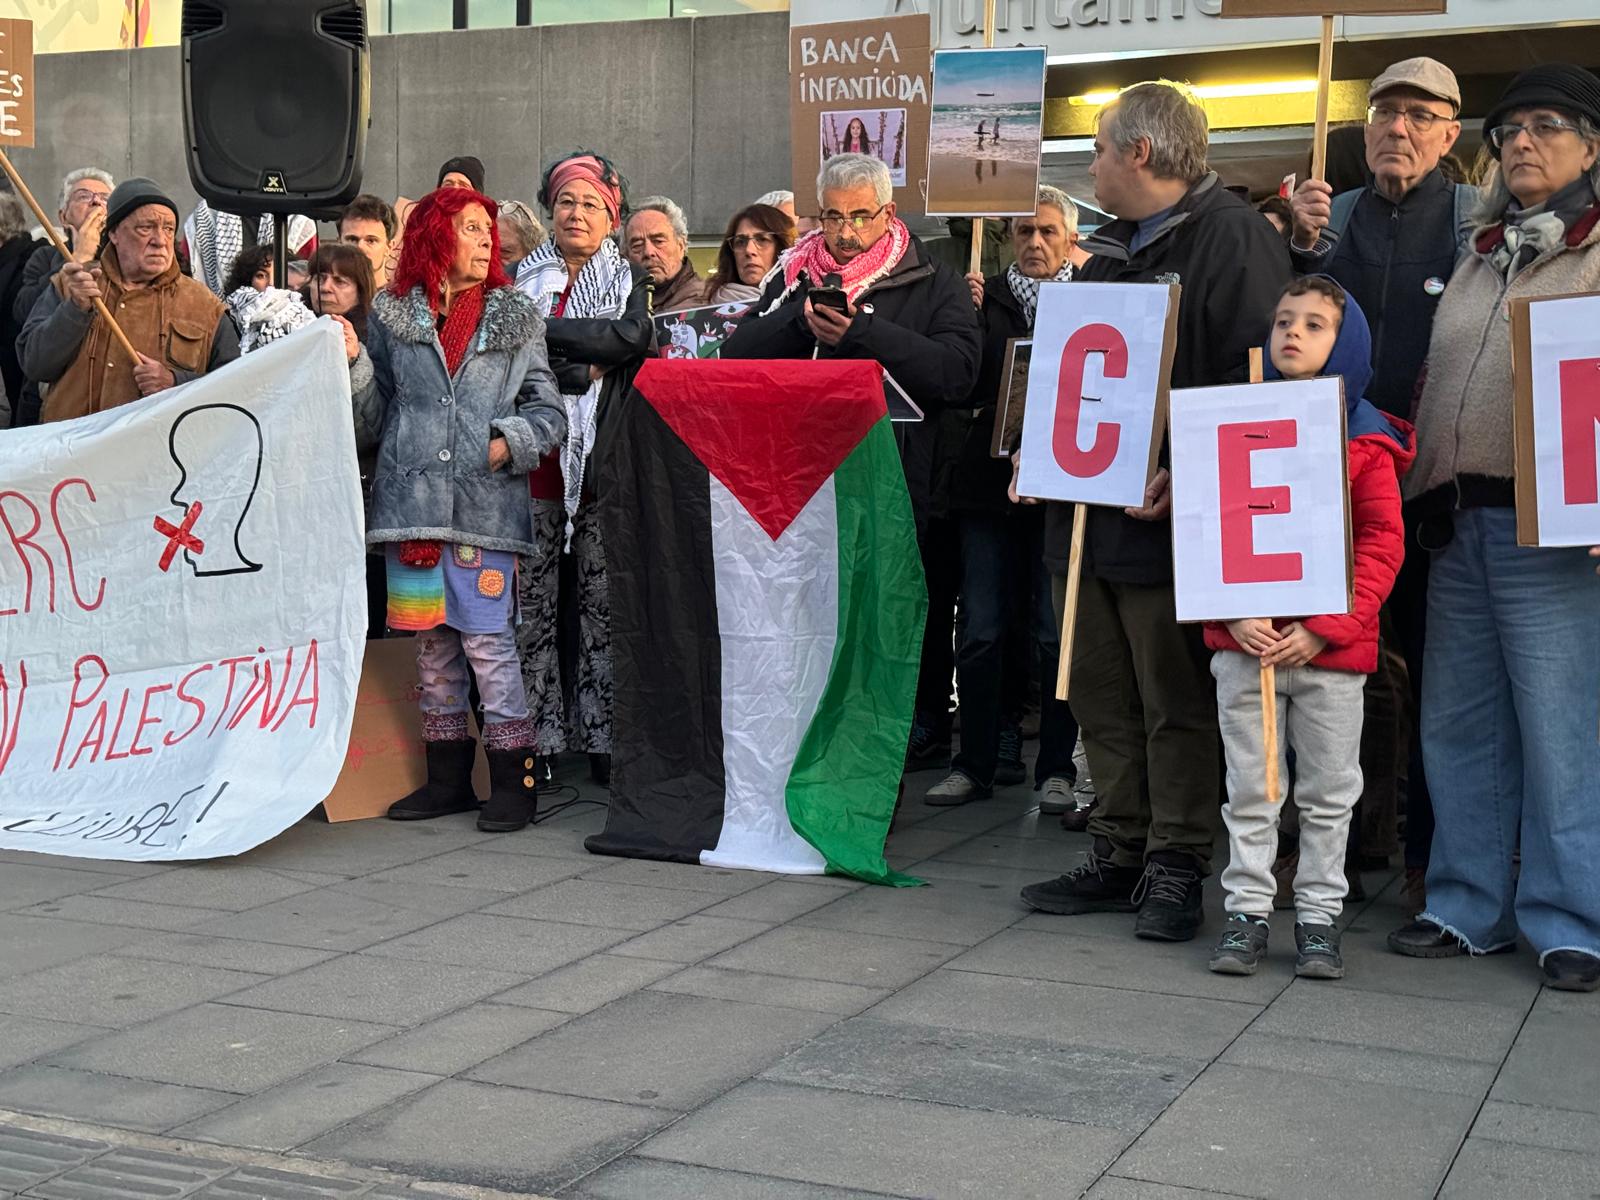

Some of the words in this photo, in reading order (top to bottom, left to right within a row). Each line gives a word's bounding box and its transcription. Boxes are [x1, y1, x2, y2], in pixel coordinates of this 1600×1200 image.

[800, 31, 900, 66] BANCA
[1052, 322, 1129, 478] C
[0, 478, 106, 616] RC
[1217, 419, 1303, 584] E
